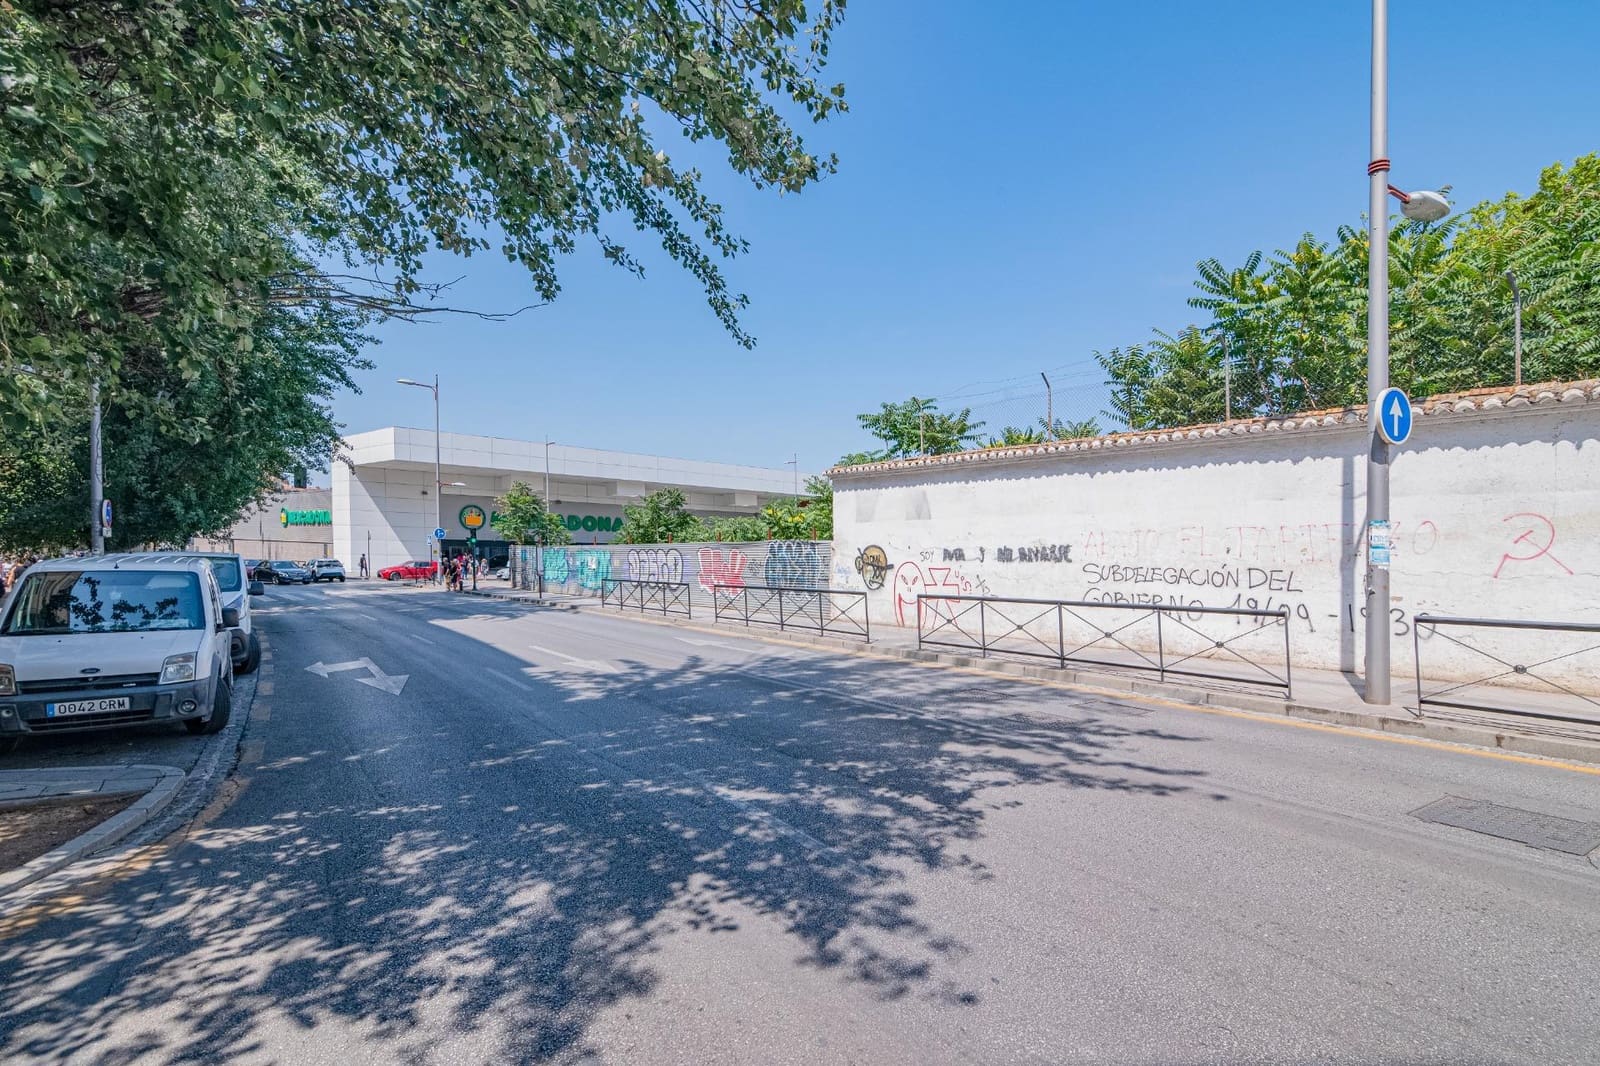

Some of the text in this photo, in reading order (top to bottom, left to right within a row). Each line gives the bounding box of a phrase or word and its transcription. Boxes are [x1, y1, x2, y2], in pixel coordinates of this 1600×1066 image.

[1082, 562, 1303, 592] SUBDELEGACIÓN DEL
[58, 699, 126, 714] 0042 CRM
